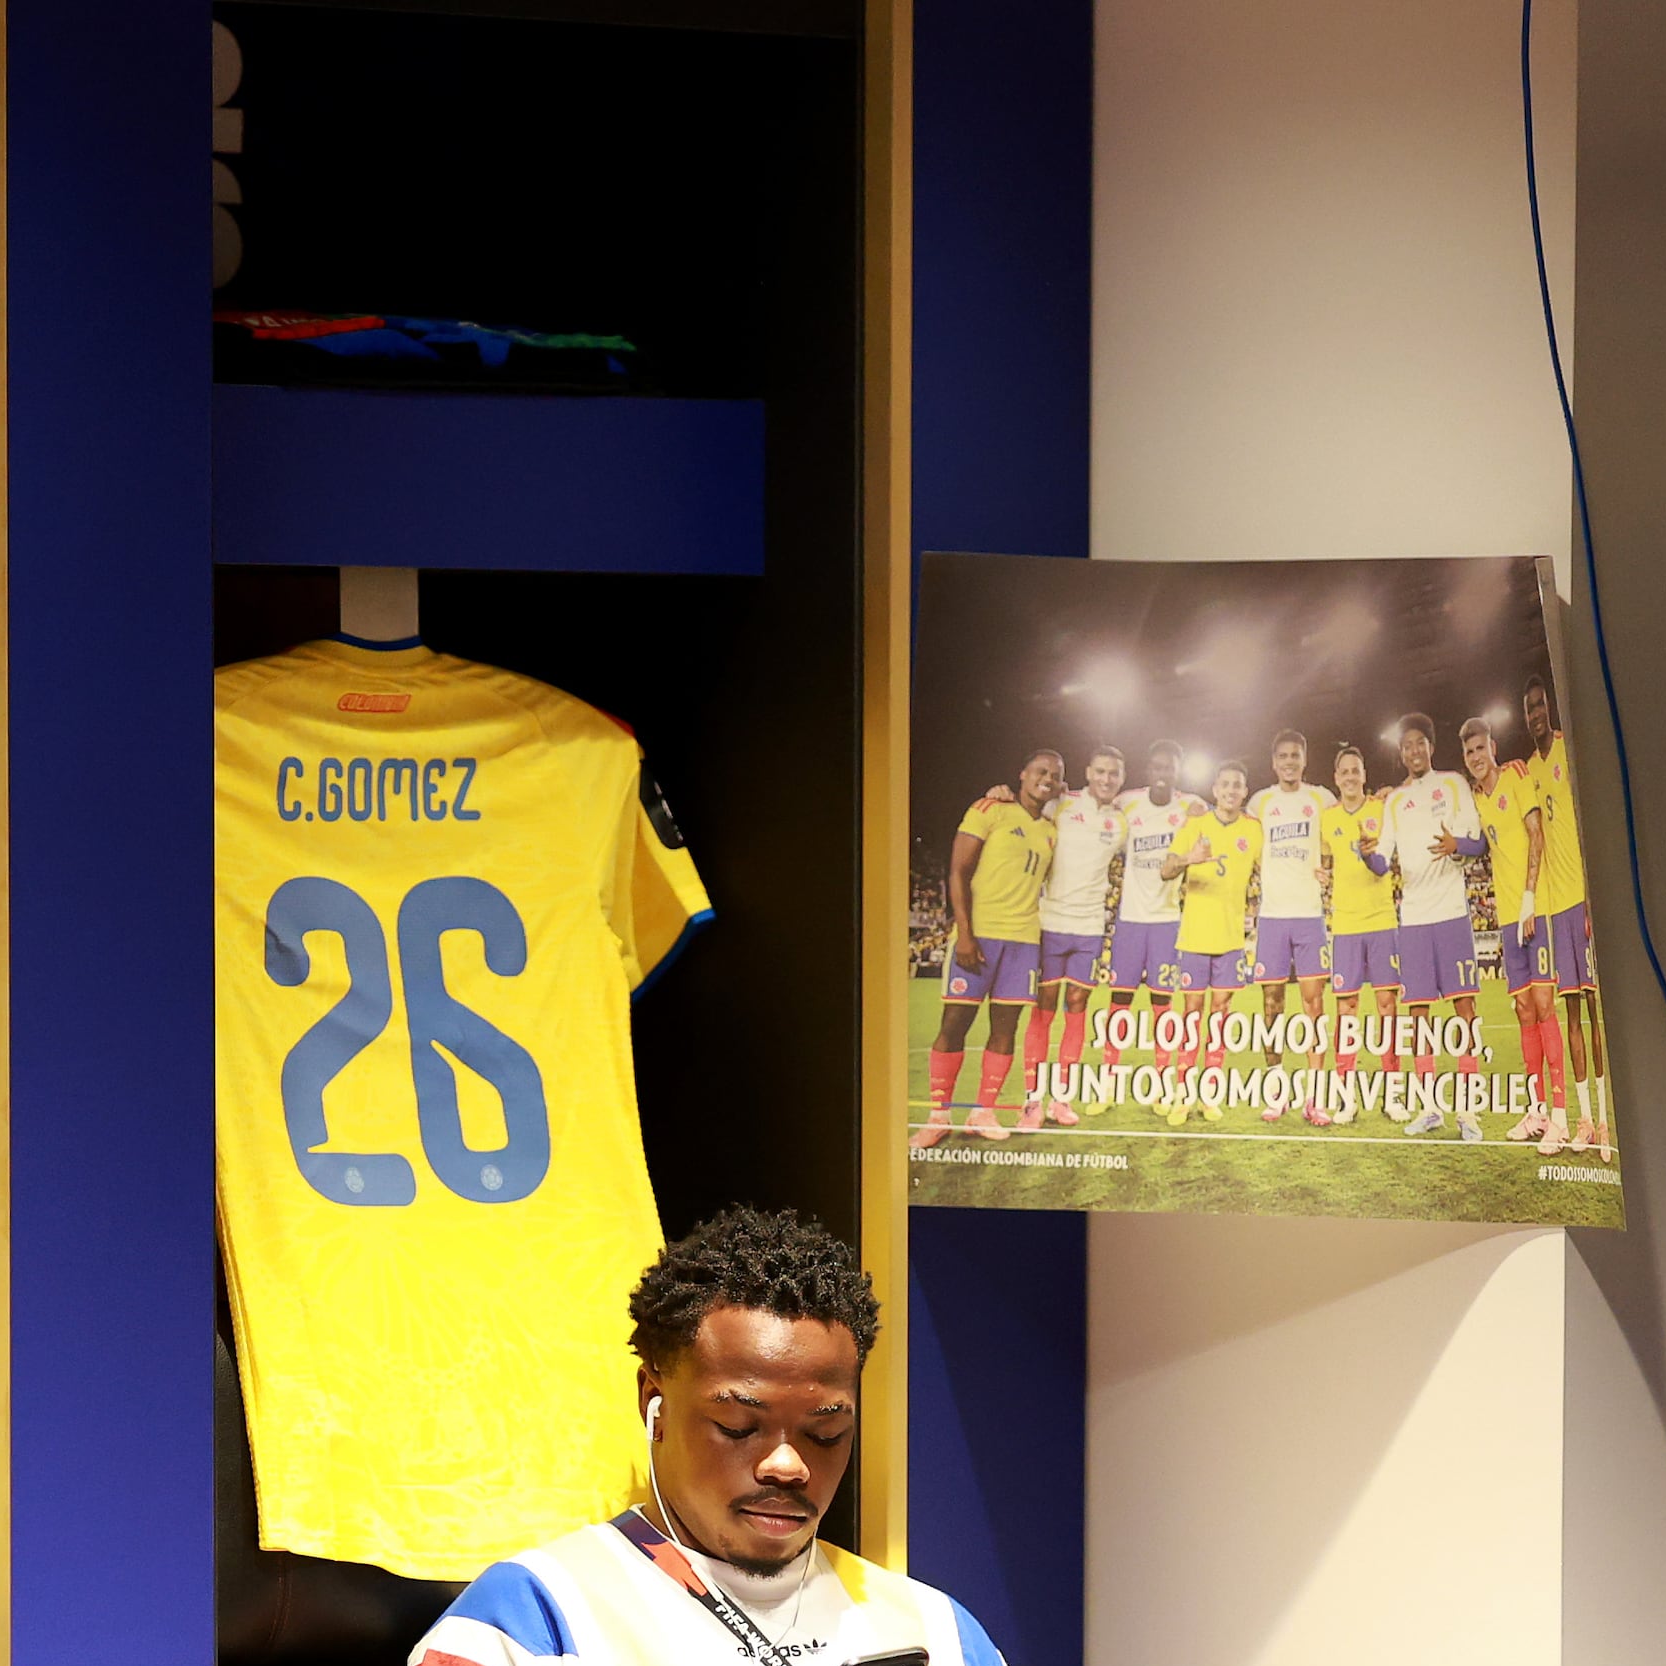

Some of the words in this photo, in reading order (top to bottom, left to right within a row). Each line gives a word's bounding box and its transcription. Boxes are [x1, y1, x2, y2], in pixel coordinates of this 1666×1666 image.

[277, 757, 481, 822] C.GOMEZ
[1456, 960, 1476, 987] 17
[265, 876, 551, 1207] 26
[1091, 1008, 1202, 1051] SOLOS
[1207, 1013, 1329, 1056] SOMOS
[1337, 1015, 1494, 1064] BUENOS,
[1027, 1062, 1176, 1106] JUNTOS
[1182, 1065, 1306, 1110] SOMOS
[1314, 1070, 1549, 1115] INVENCIBLES.
[983, 1150, 1063, 1167] COLOMBIANA
[1065, 1154, 1081, 1168] DE
